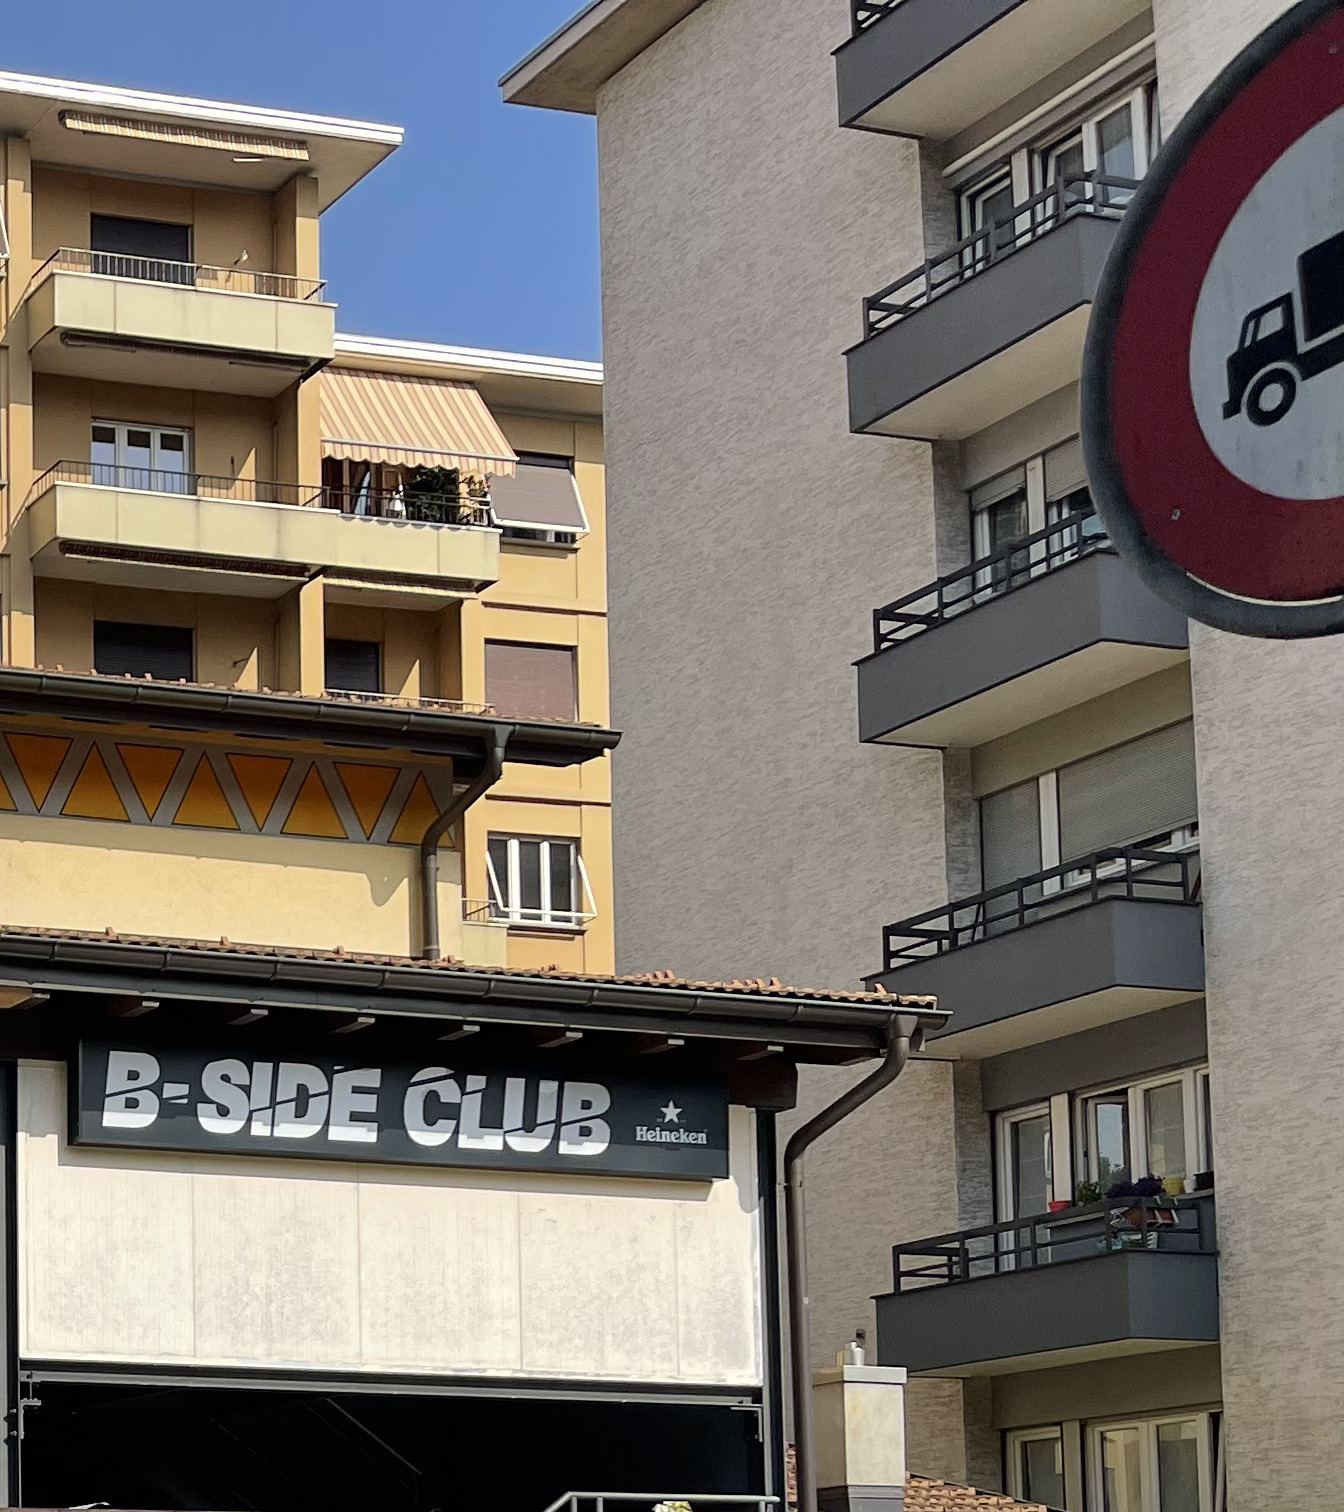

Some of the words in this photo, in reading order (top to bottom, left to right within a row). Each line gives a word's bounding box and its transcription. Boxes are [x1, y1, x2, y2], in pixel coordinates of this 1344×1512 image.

[101, 1050, 383, 1142] B-SIDE
[403, 1066, 613, 1156] CLUB
[635, 1125, 709, 1145] Heineken
